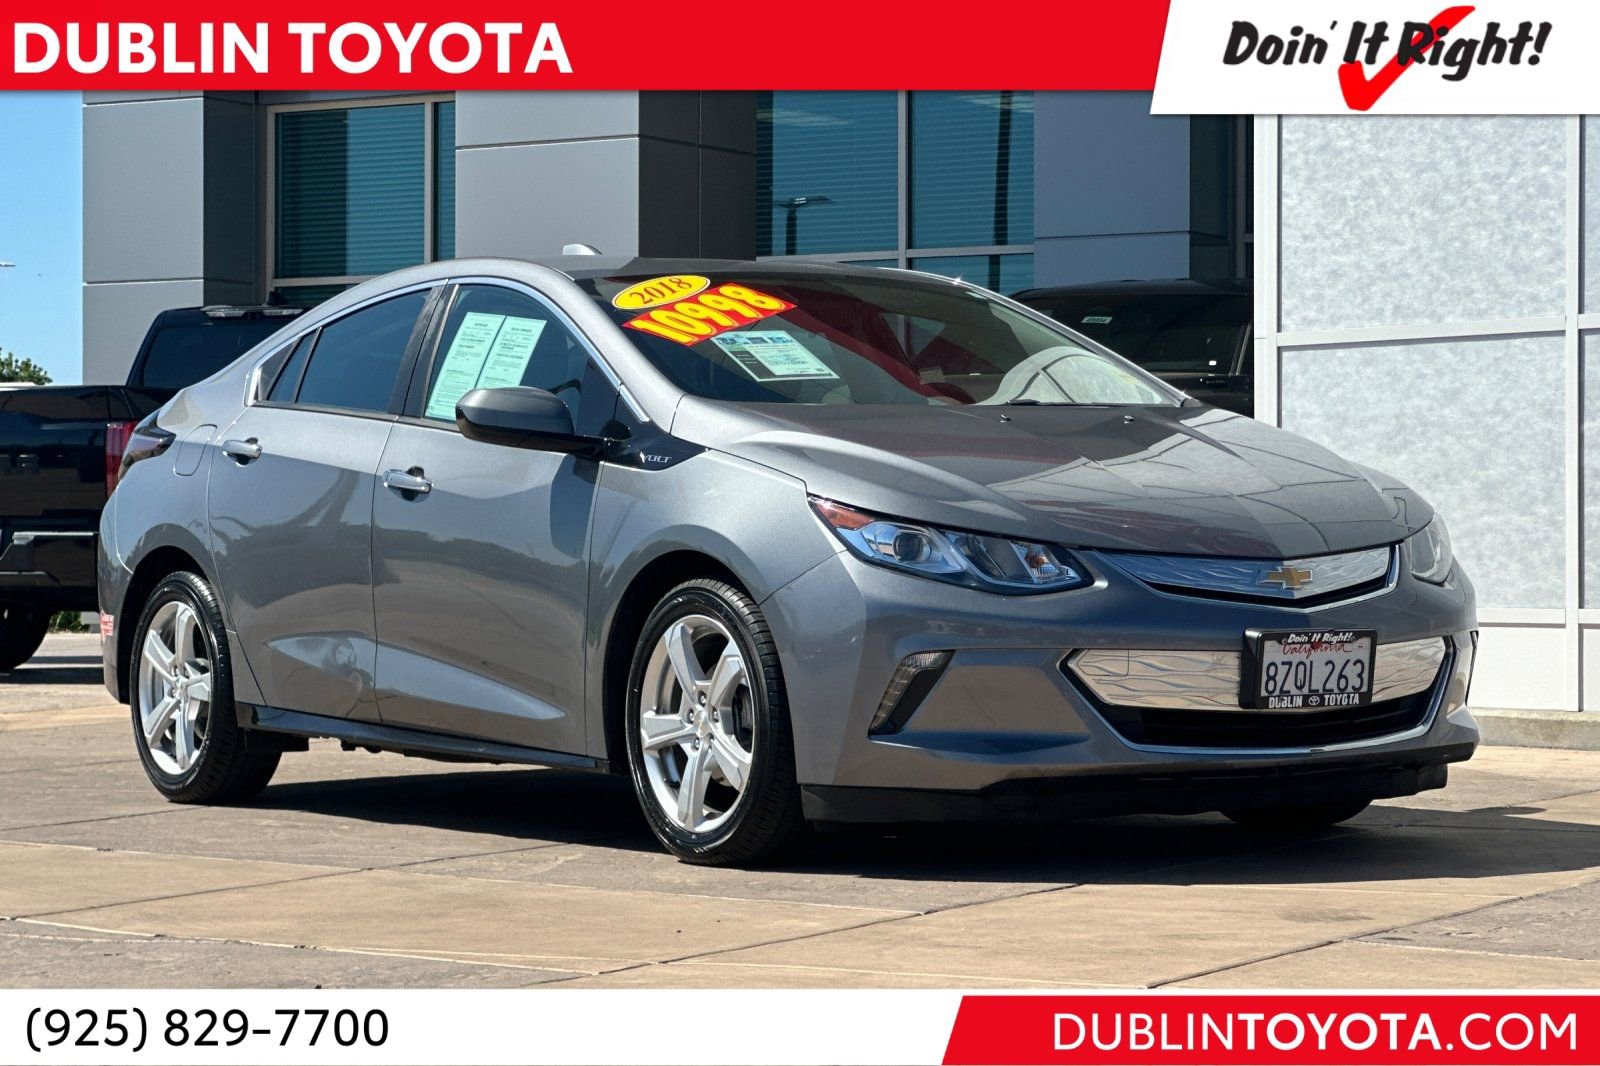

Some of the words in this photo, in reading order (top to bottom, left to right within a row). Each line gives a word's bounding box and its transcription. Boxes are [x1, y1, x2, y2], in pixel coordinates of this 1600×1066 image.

[629, 277, 692, 304] 2018
[630, 285, 786, 344] 10998
[640, 451, 673, 464] VOLT
[1311, 633, 1322, 643] It
[1322, 632, 1353, 643] Right!
[1264, 659, 1365, 695] 8ZQL263
[1268, 695, 1303, 709] DUBLIN
[1324, 693, 1360, 706] TOYOTA
